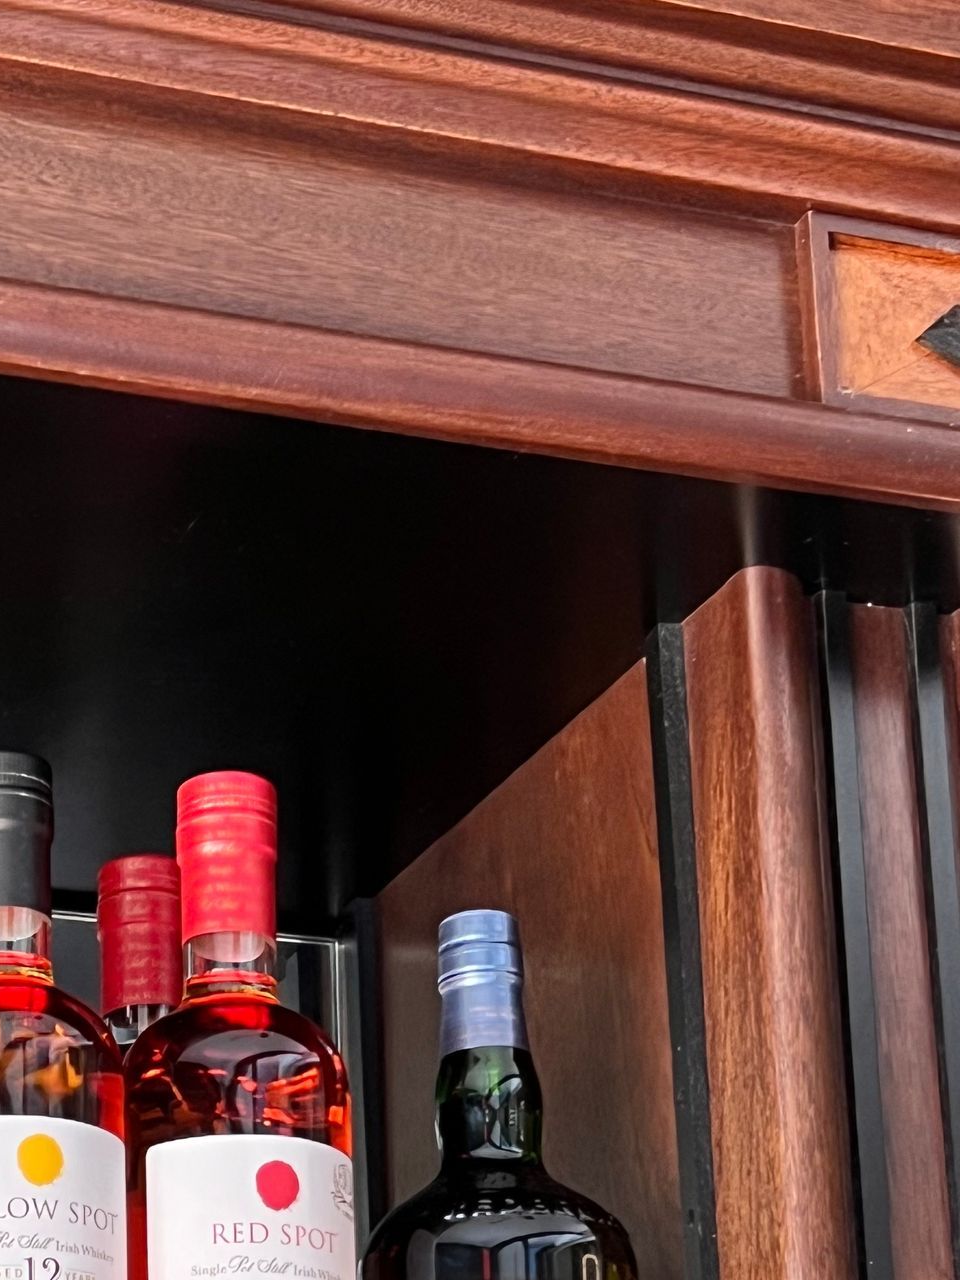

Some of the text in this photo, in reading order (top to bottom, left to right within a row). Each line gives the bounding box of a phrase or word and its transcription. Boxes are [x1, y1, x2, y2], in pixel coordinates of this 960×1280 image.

[69, 1202, 118, 1235] SPOT
[18, 1233, 54, 1249] Still
[56, 1240, 79, 1254] Irish
[82, 1244, 114, 1267] Whiskey
[212, 1223, 339, 1253] RED SPOT
[191, 1256, 316, 1278] Single Pot Still Irish
